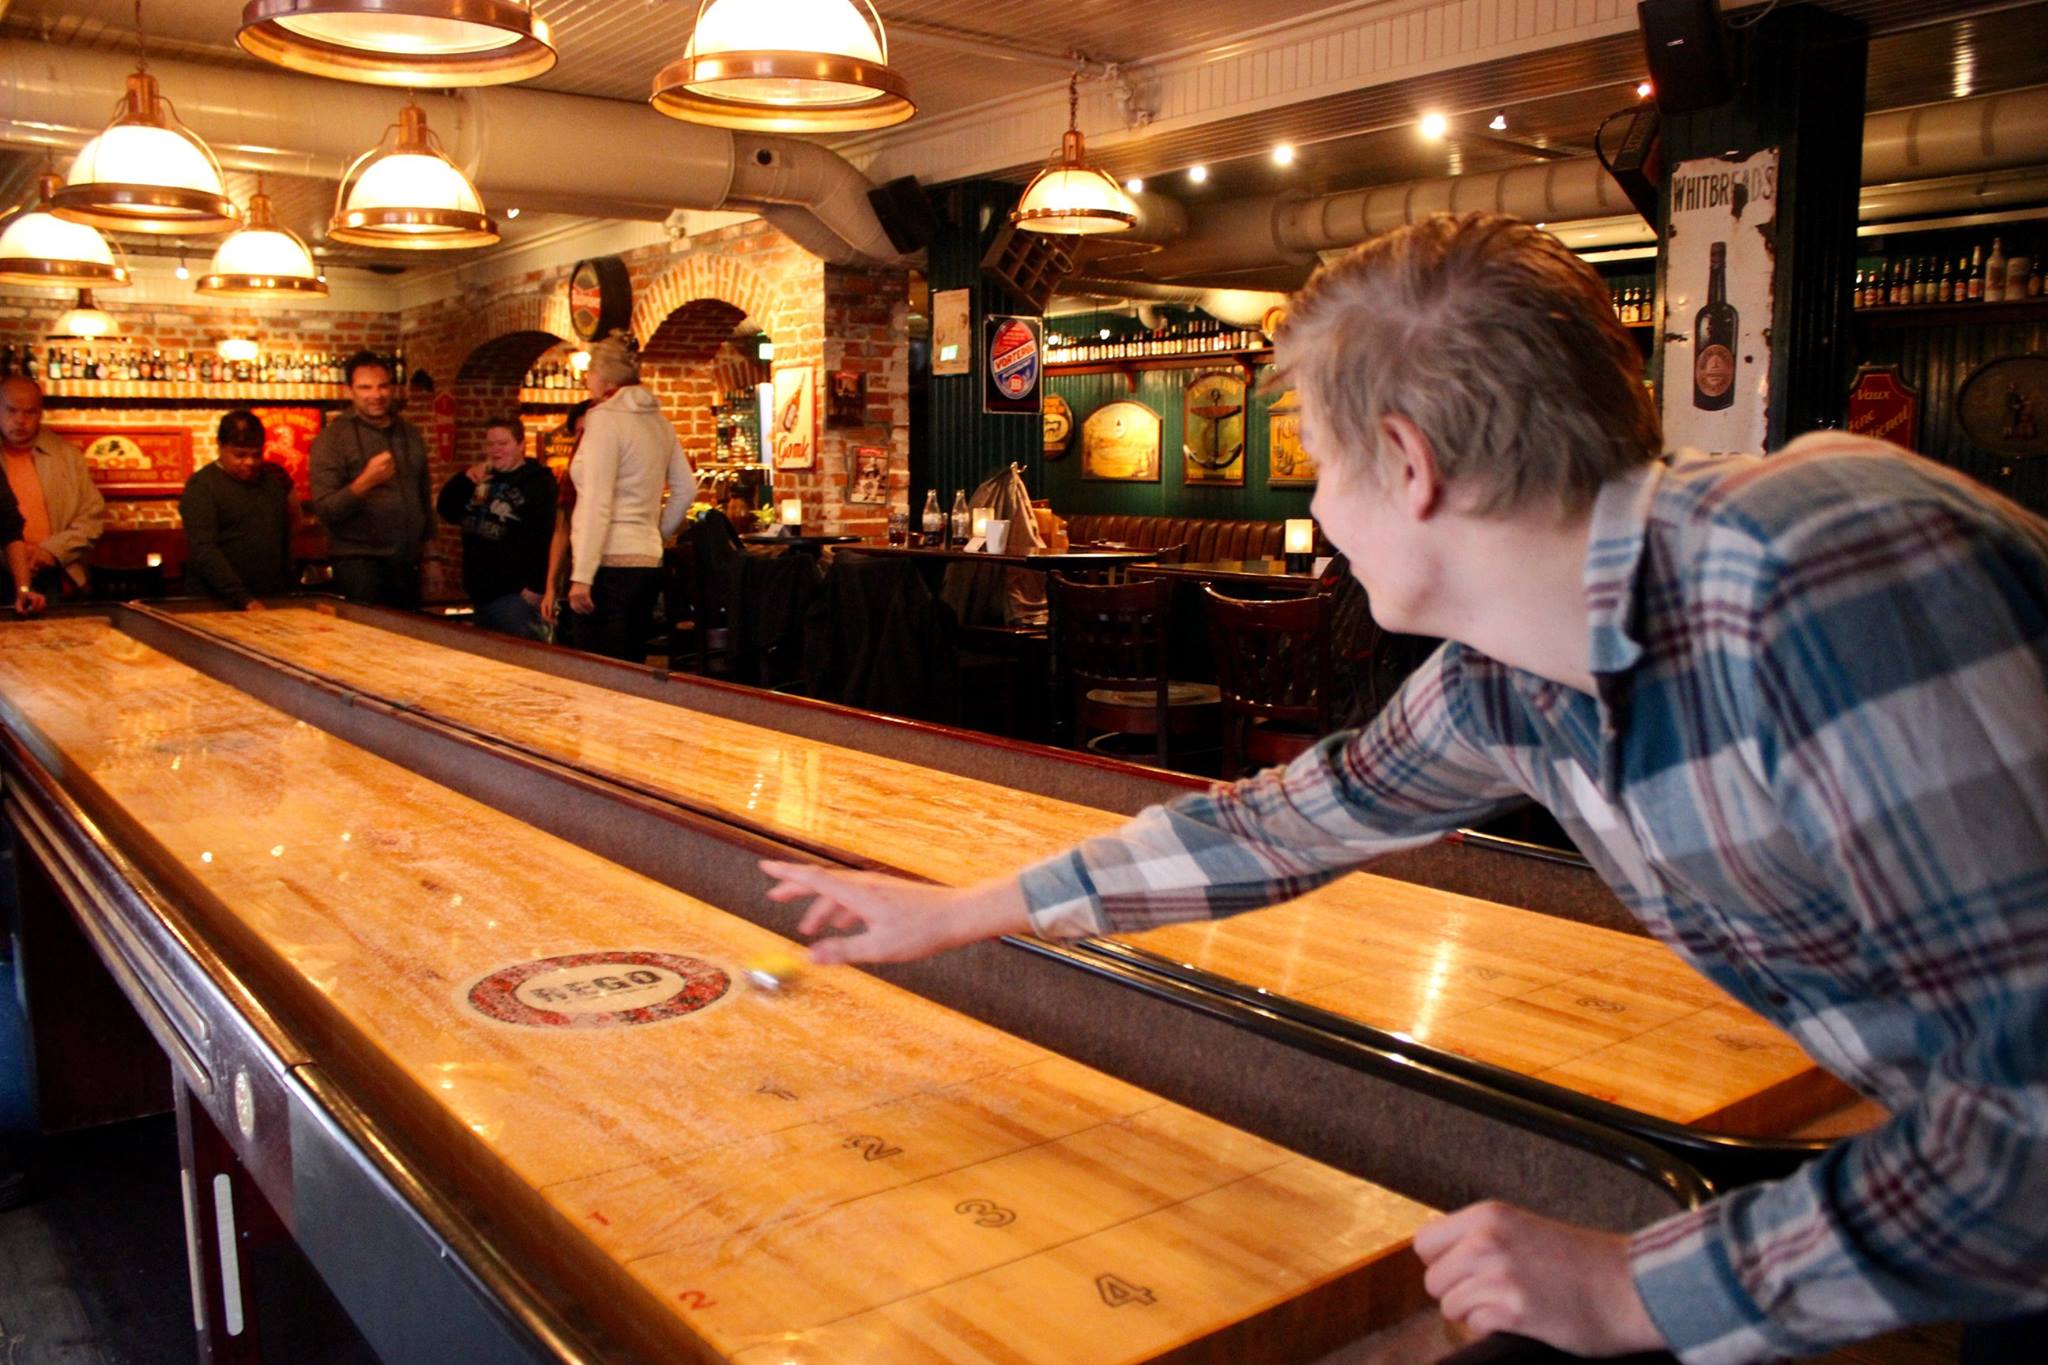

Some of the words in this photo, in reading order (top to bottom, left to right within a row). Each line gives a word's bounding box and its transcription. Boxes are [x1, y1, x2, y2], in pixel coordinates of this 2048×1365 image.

[1857, 388, 1889, 400] Vaux
[841, 1133, 905, 1163] 2
[954, 1198, 1018, 1229] 3
[677, 1289, 719, 1312] 2
[1095, 1272, 1159, 1308] 4
